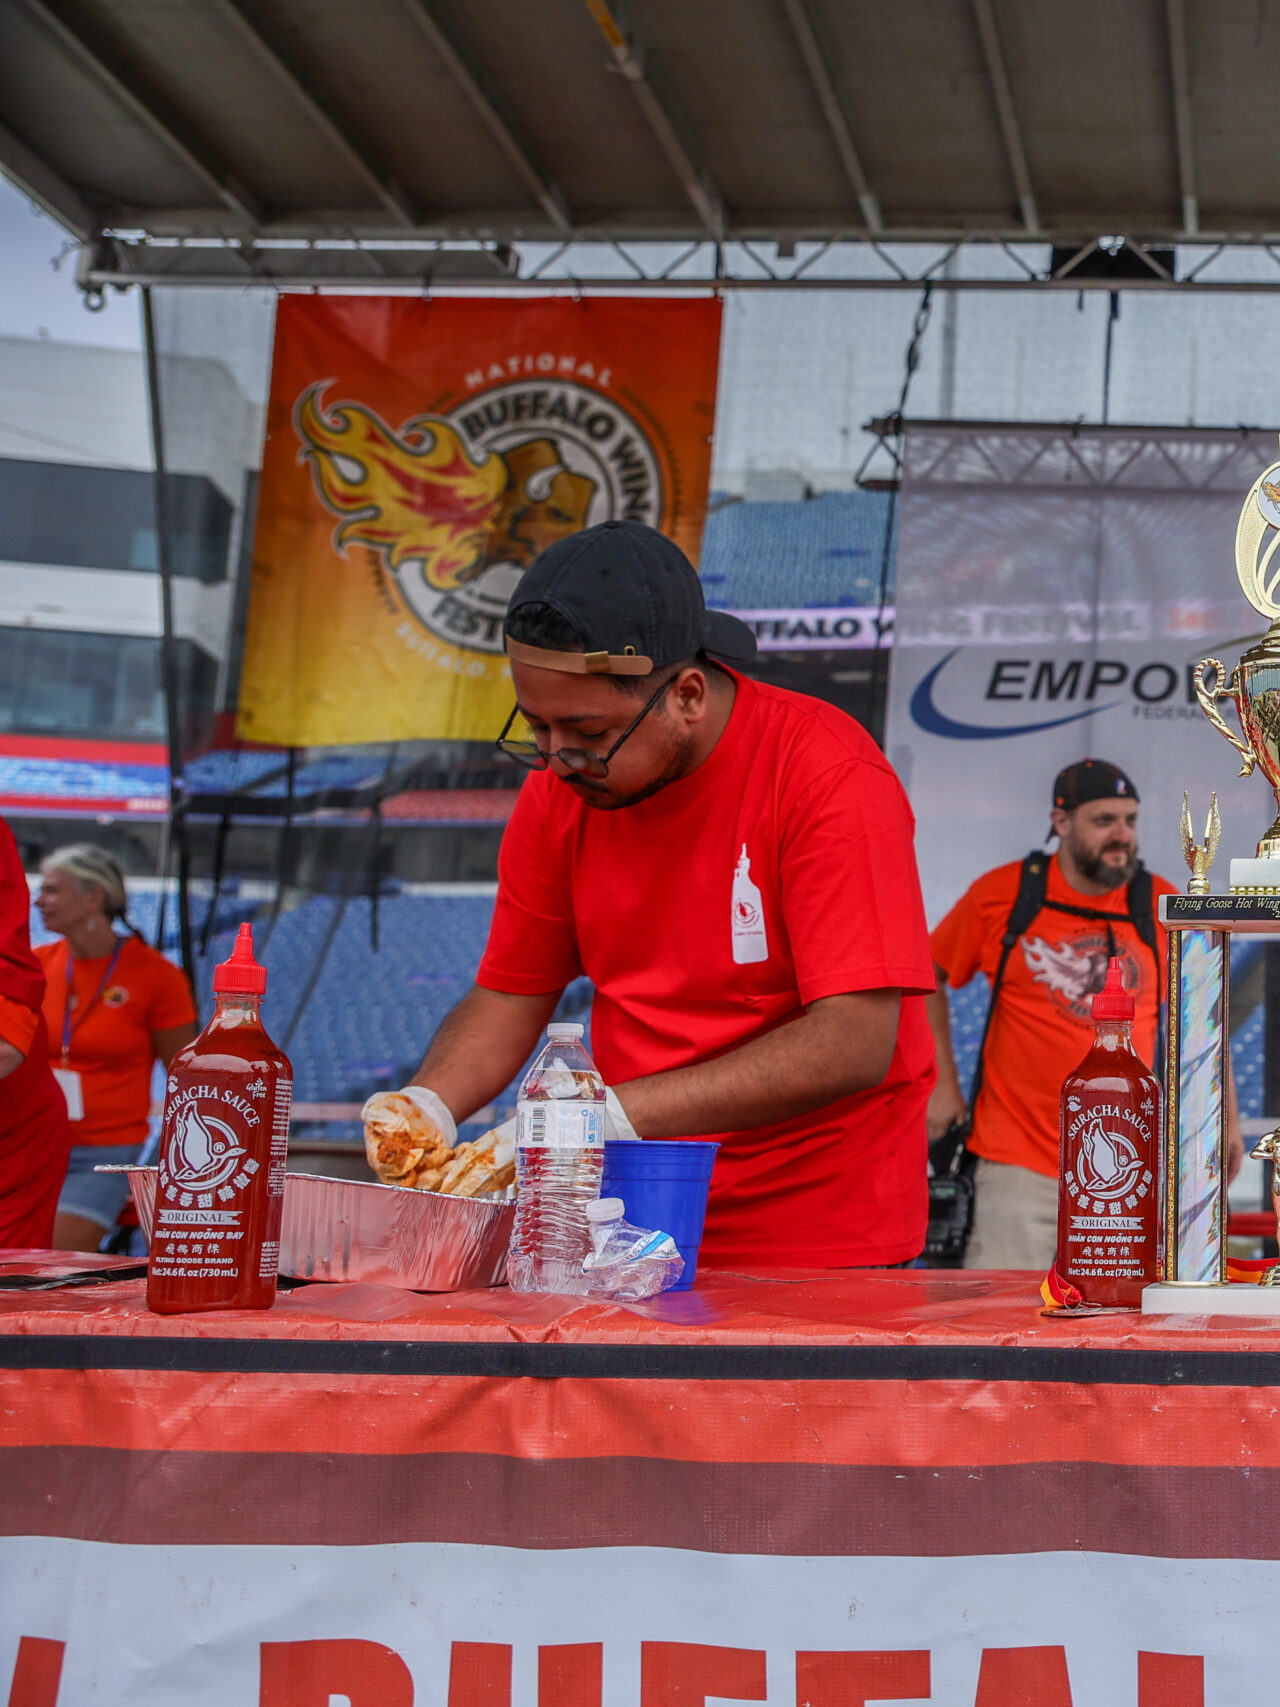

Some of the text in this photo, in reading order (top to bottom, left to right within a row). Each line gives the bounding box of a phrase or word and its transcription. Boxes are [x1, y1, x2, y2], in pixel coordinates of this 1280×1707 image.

[464, 352, 612, 388] NATIONAL
[460, 390, 652, 521] BUFFALO WIN
[431, 597, 505, 642] FEST
[755, 617, 861, 640] FFALO
[1173, 897, 1203, 911] Flying
[1206, 898, 1232, 909] Goose
[1235, 898, 1253, 909] Hot
[1257, 898, 1280, 911] Wing
[165, 1085, 219, 1125] SRIRACHA
[221, 1090, 262, 1128] SAUCE
[1068, 1105, 1120, 1140] SRIRACHA
[1122, 1108, 1152, 1142] SAUCE
[167, 1213, 225, 1223] ORIGINAL
[1081, 1218, 1132, 1228] ORIGINAL
[170, 1231, 187, 1239] CON
[226, 1231, 244, 1240] BAY
[1086, 1235, 1103, 1243] CON
[1133, 1235, 1146, 1243] BAY
